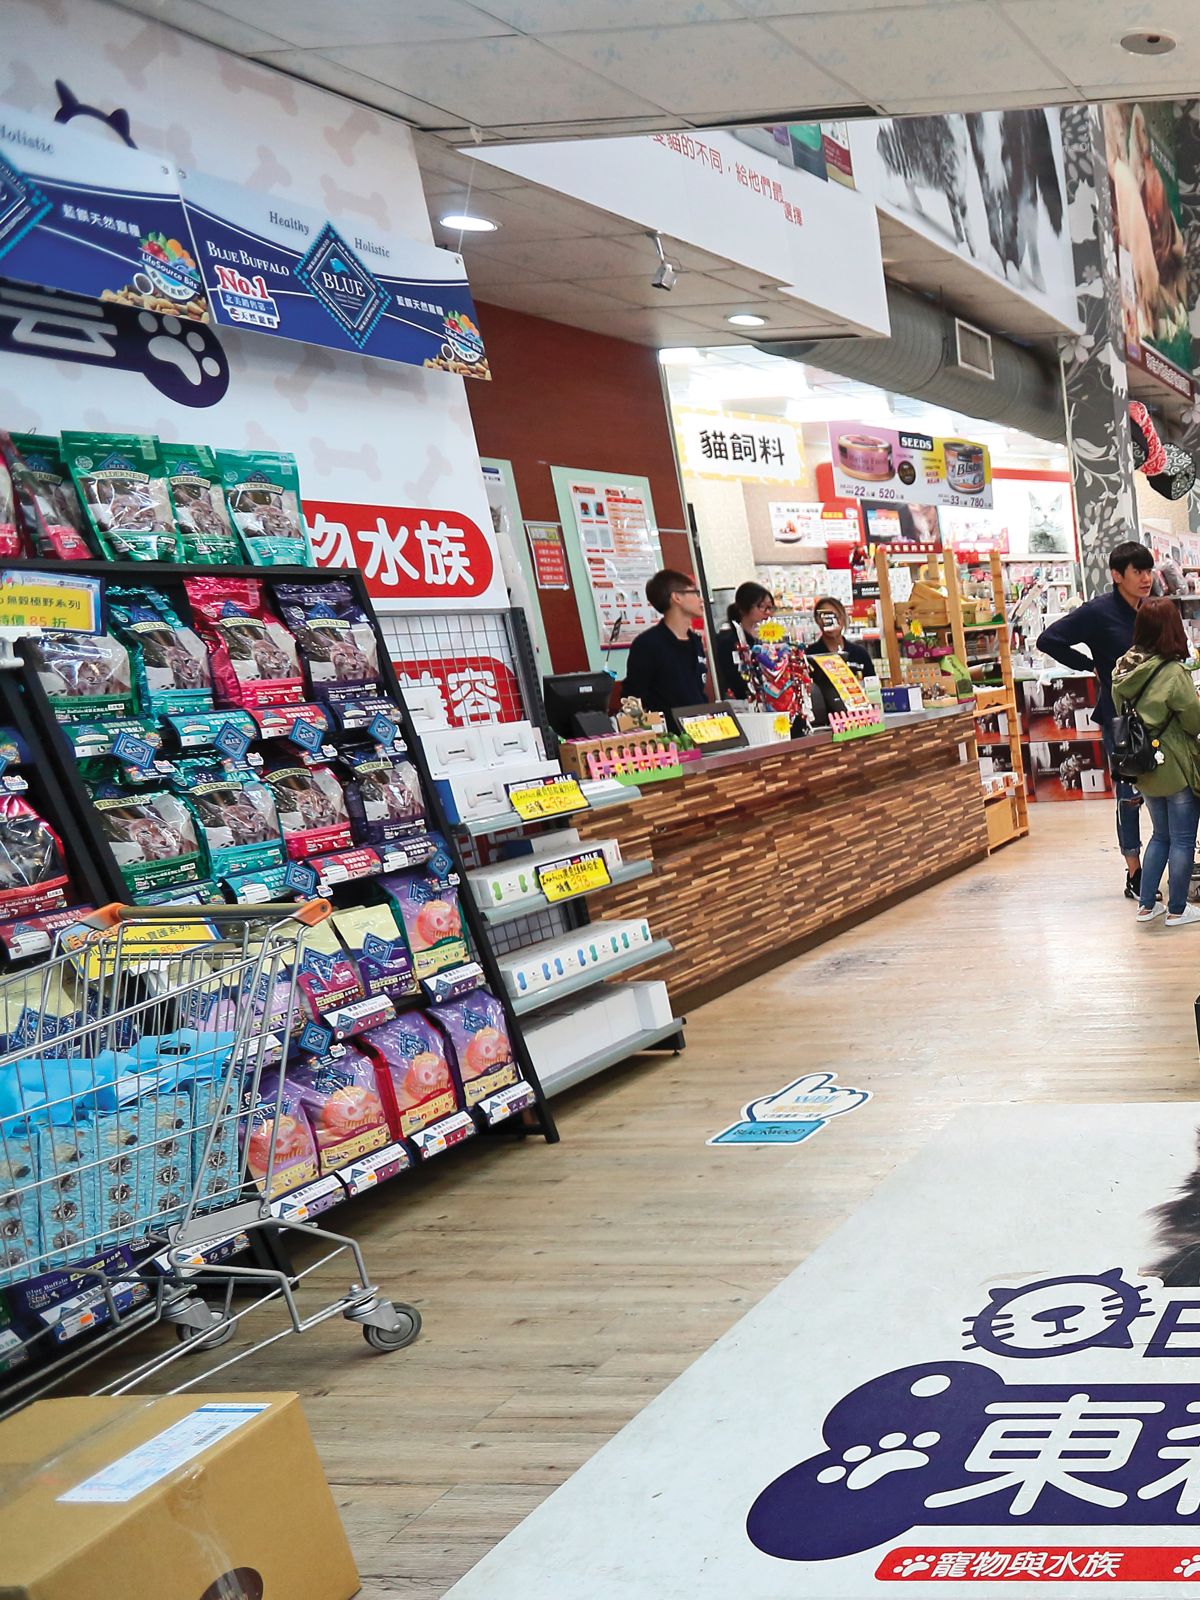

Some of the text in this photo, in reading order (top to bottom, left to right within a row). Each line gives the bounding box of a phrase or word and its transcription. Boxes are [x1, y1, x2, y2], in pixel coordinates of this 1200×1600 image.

[269, 211, 310, 237] Healthy
[206, 240, 240, 265] BLUE
[241, 249, 290, 277] BUFFALO
[354, 237, 391, 259] Holistic
[214, 265, 269, 299] No.1
[321, 271, 366, 298] BLUE
[698, 428, 787, 466] 貓飼料
[901, 436, 933, 450] SEEDS
[88, 470, 150, 483] WILDERNESS
[855, 486, 866, 497] 22
[878, 487, 896, 500] 520
[553, 774, 573, 784] SALE
[579, 851, 599, 862] SALE
[934, 1549, 1123, 1580] 寵物與水族
